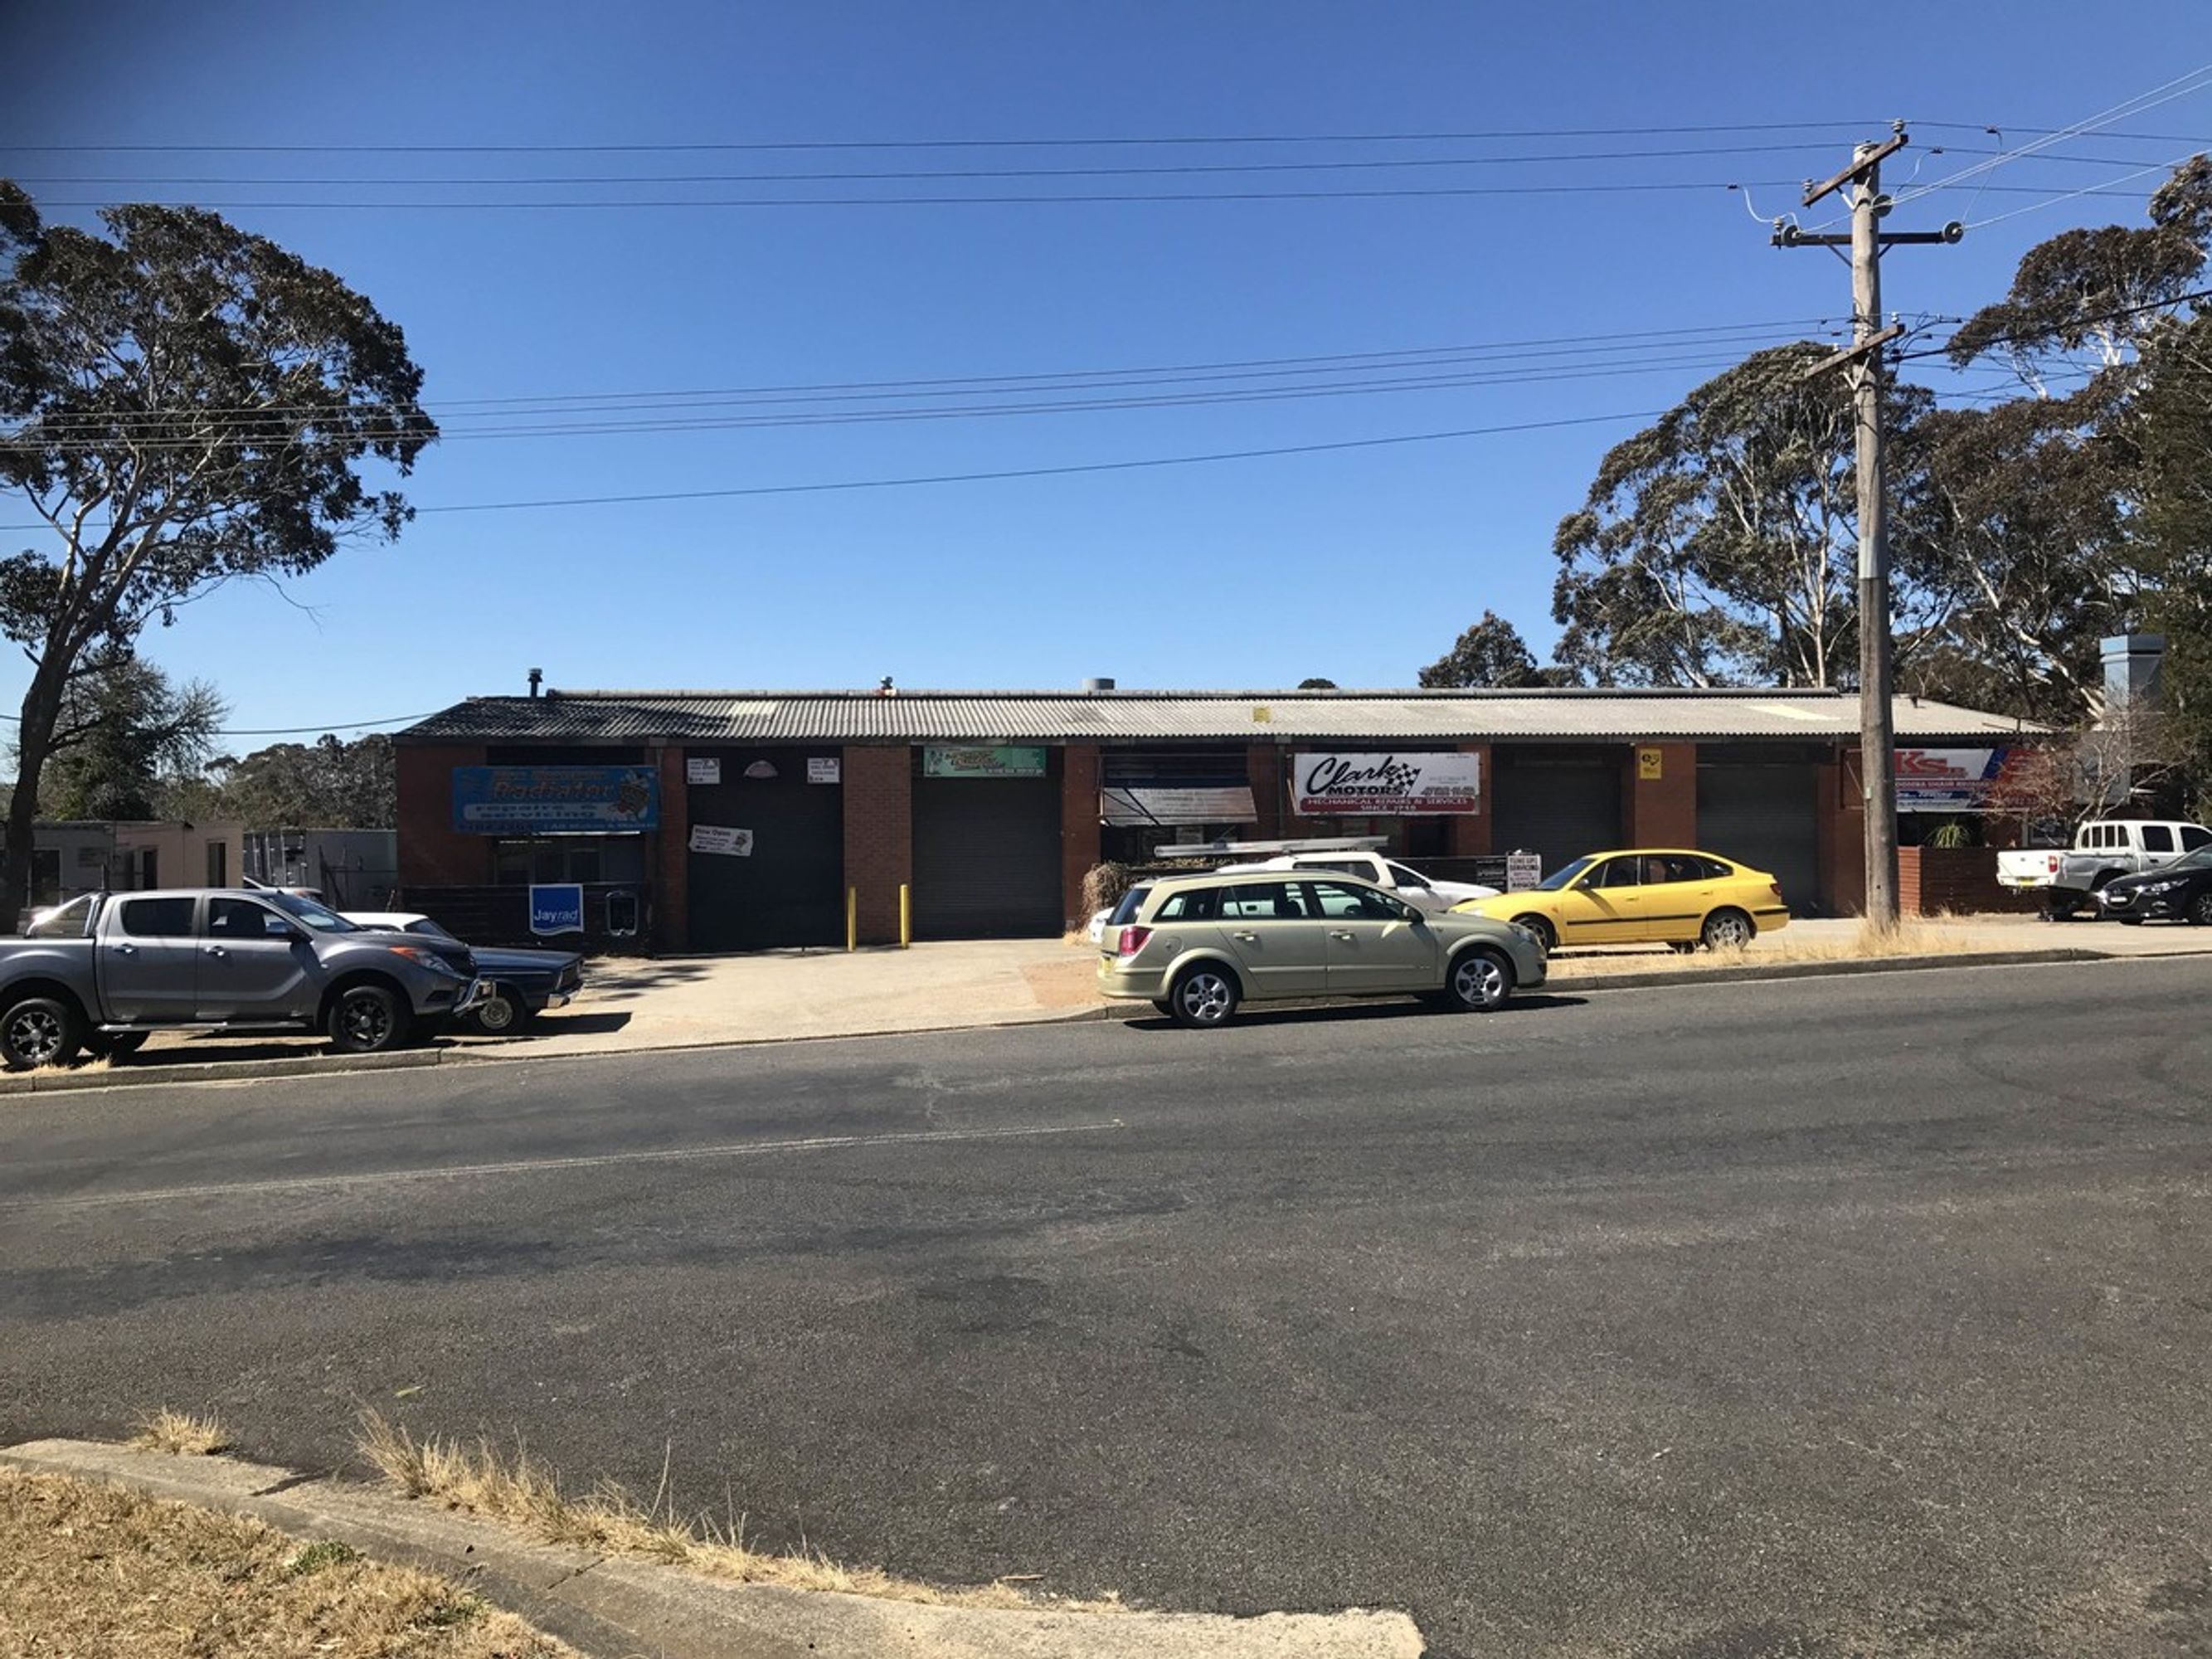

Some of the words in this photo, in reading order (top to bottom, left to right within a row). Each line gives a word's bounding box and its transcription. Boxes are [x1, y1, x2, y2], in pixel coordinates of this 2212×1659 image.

[1307, 756, 1398, 795] Clark
[1327, 786, 1403, 795] MOTORS
[533, 909, 578, 923] Jayrad
